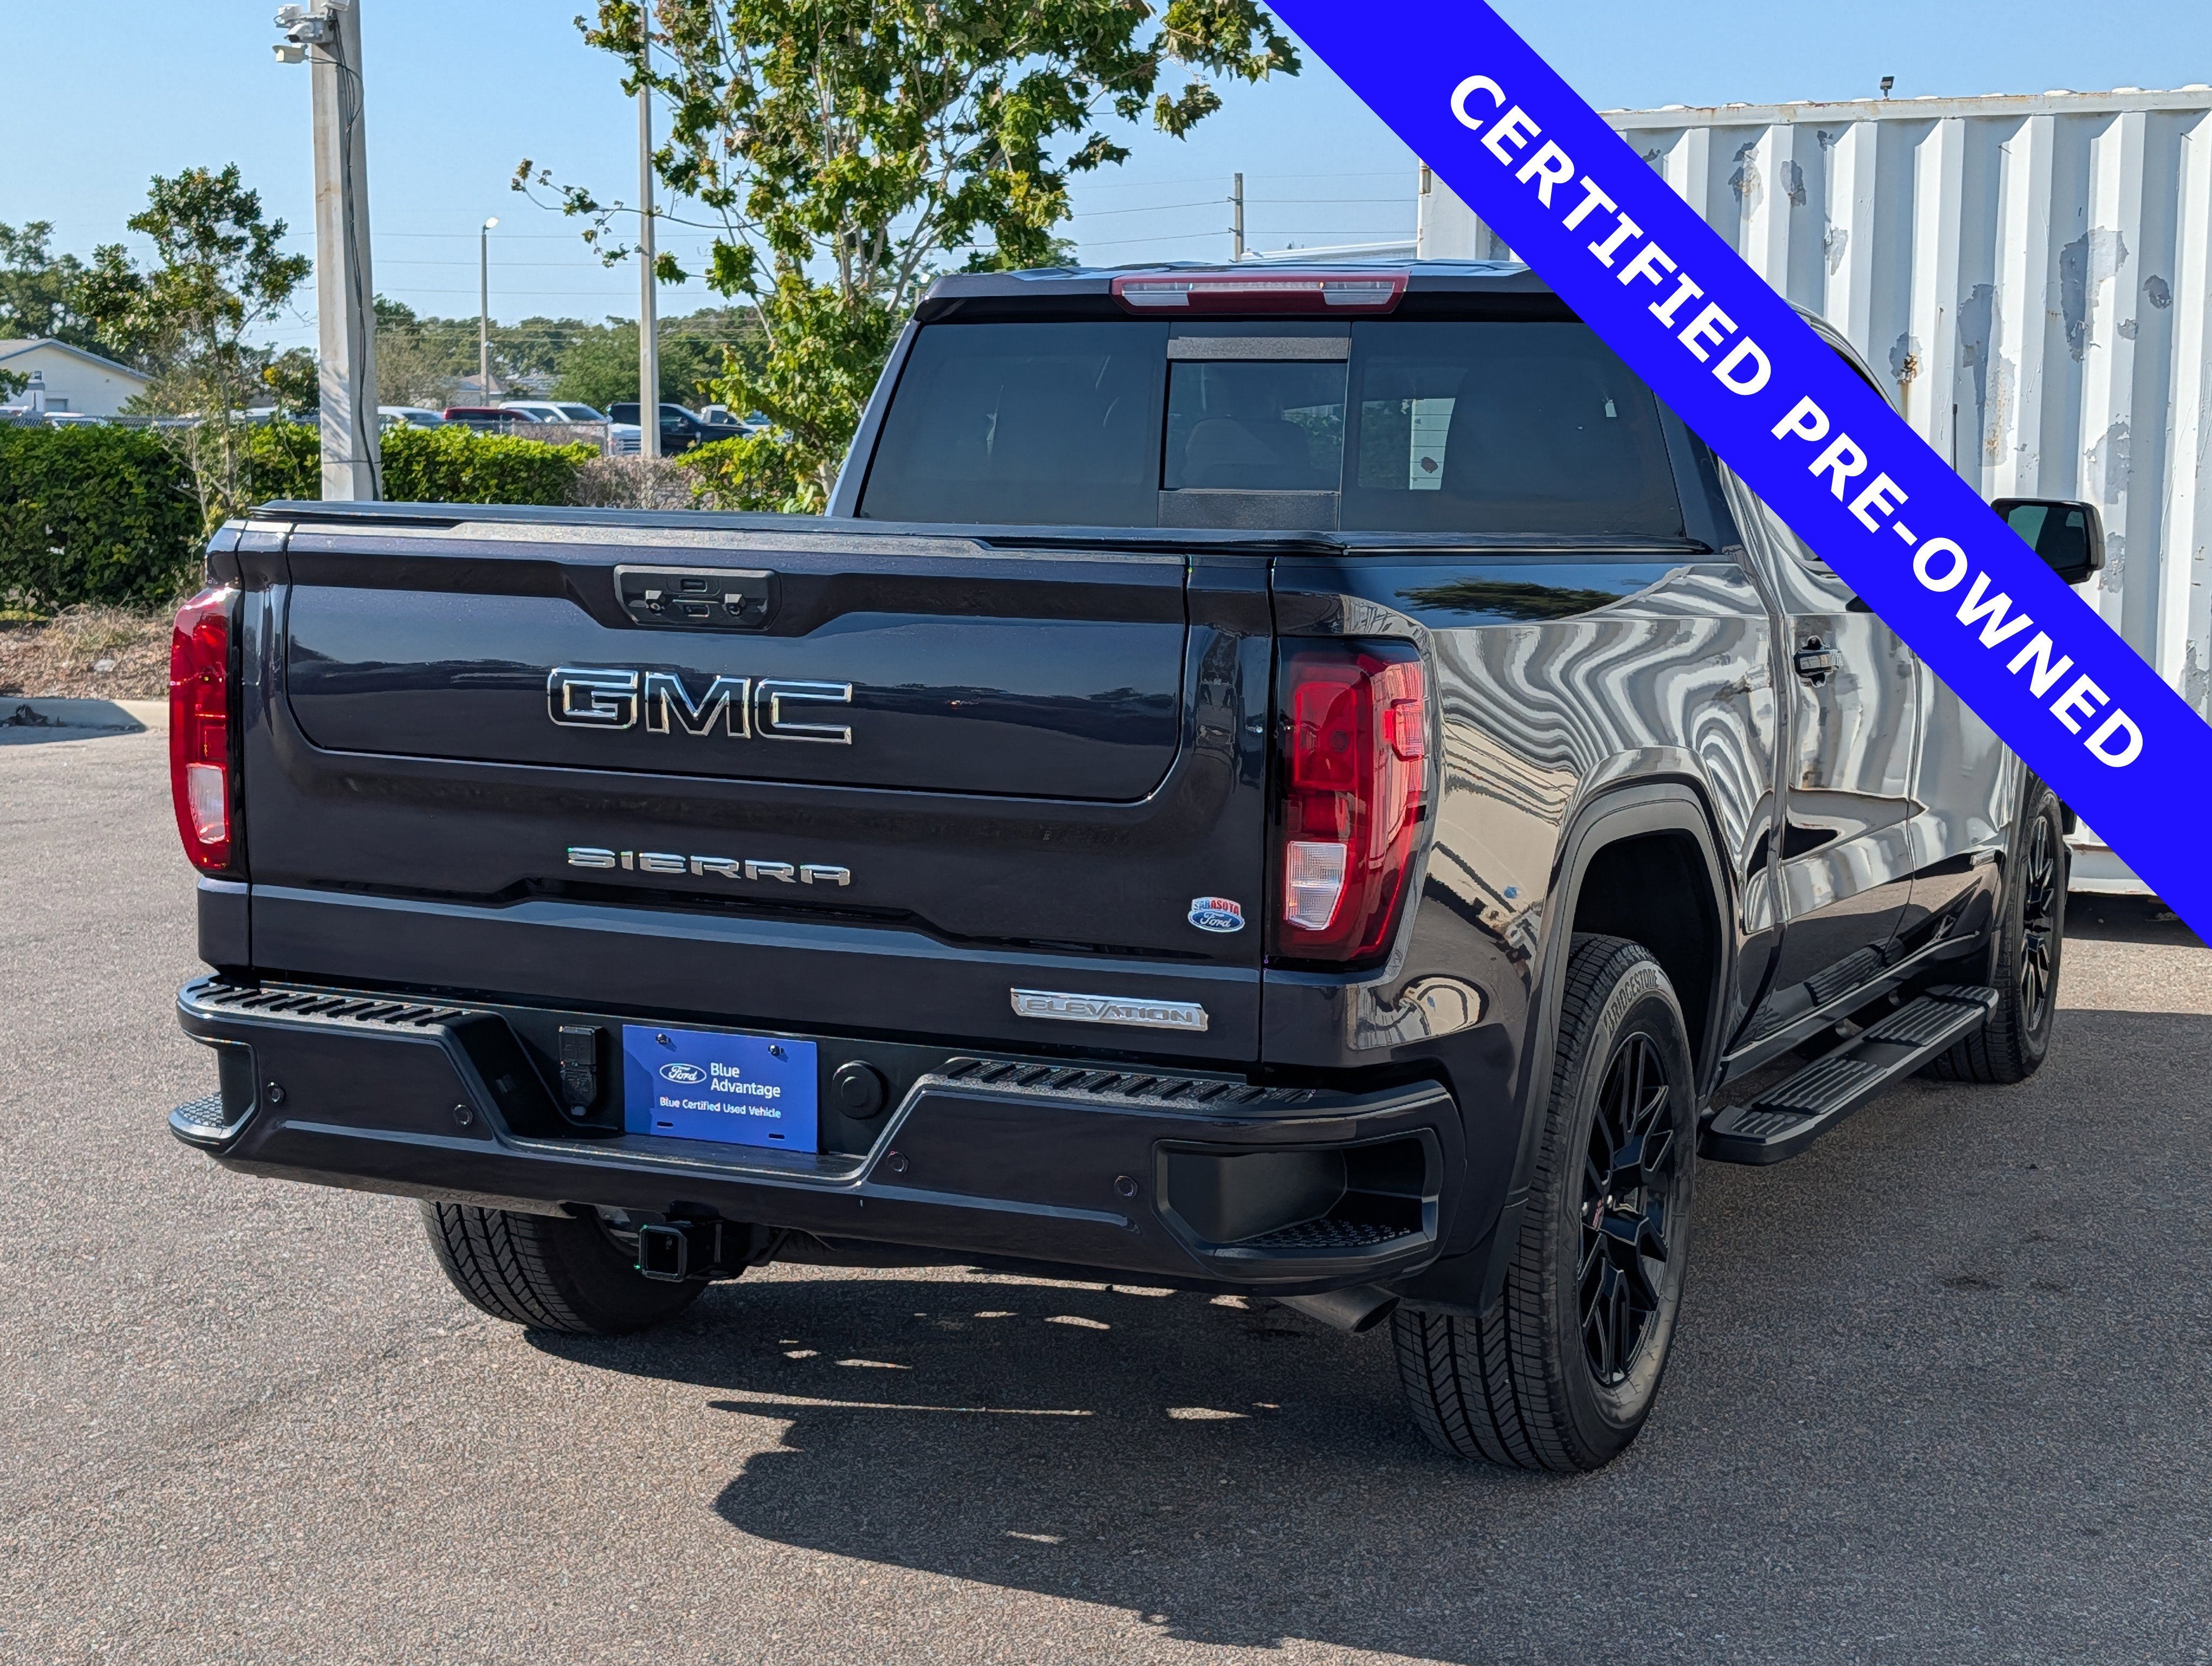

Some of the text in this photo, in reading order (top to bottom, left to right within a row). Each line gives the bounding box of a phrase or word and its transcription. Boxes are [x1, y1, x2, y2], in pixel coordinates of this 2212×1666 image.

[546, 667, 853, 745] GMC
[567, 847, 851, 886] SIERRA
[1200, 912, 1232, 927] Ford
[1025, 998, 1193, 1023] ELEVATION
[668, 1065, 698, 1081] Ford
[710, 1062, 740, 1078] Blue
[710, 1078, 781, 1099] Advantage
[659, 1097, 782, 1119] Blue Certified Used Vehicle
